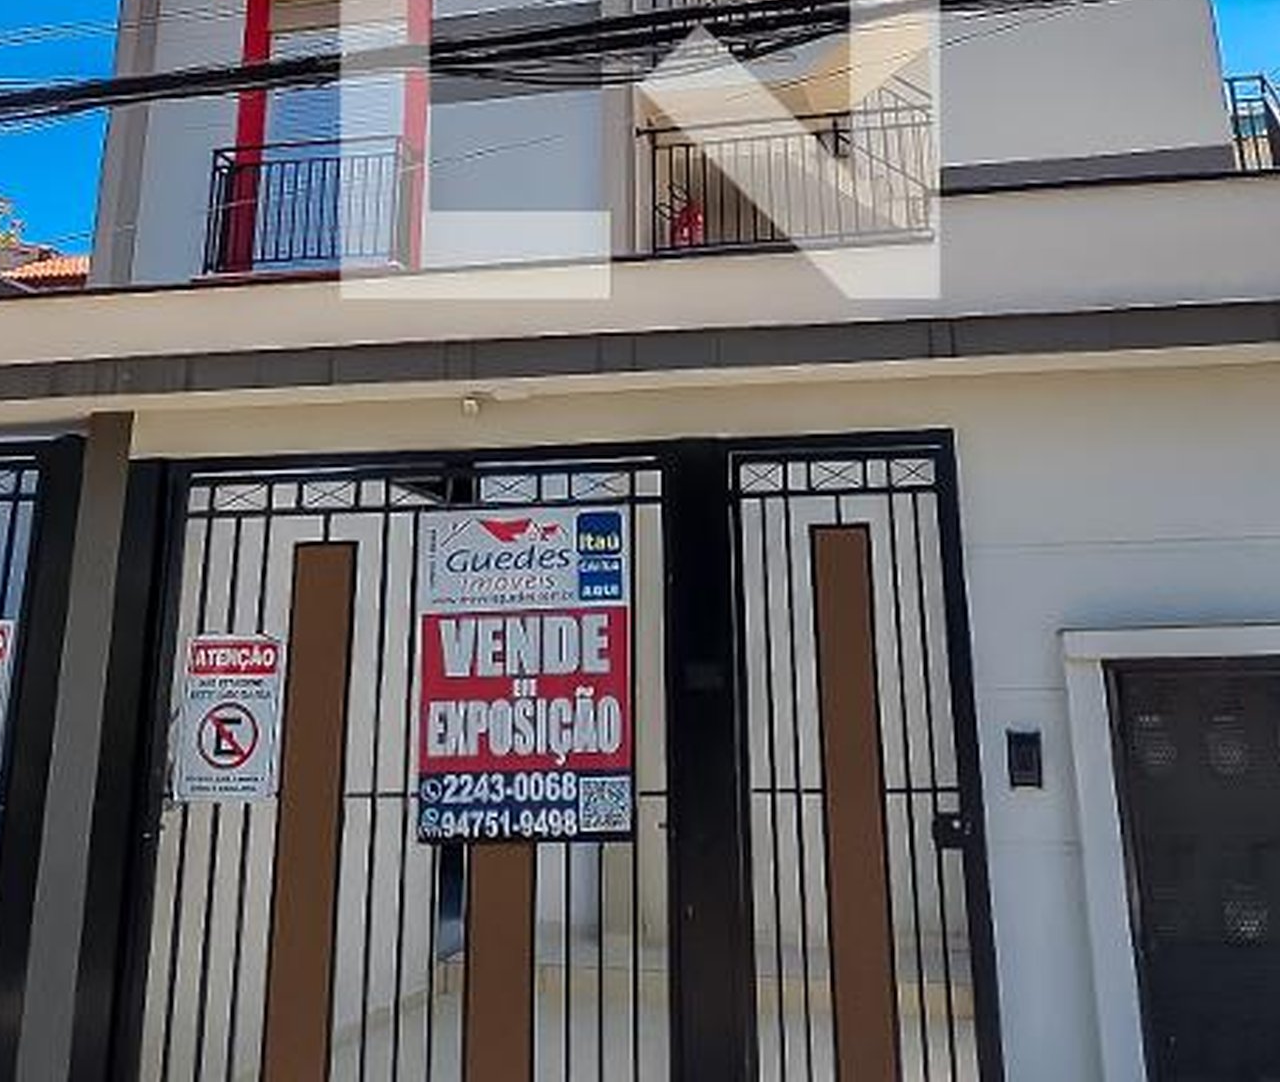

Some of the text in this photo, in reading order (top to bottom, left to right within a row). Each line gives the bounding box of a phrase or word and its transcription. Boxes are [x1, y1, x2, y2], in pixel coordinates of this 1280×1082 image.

[446, 545, 570, 573] Guedes
[195, 645, 276, 672] ATENÇÃO
[439, 614, 611, 677] VENDE
[426, 685, 621, 766] EXPOSIÇÃO
[442, 771, 578, 804] 2243-0068
[442, 808, 578, 838] 94751-9498
